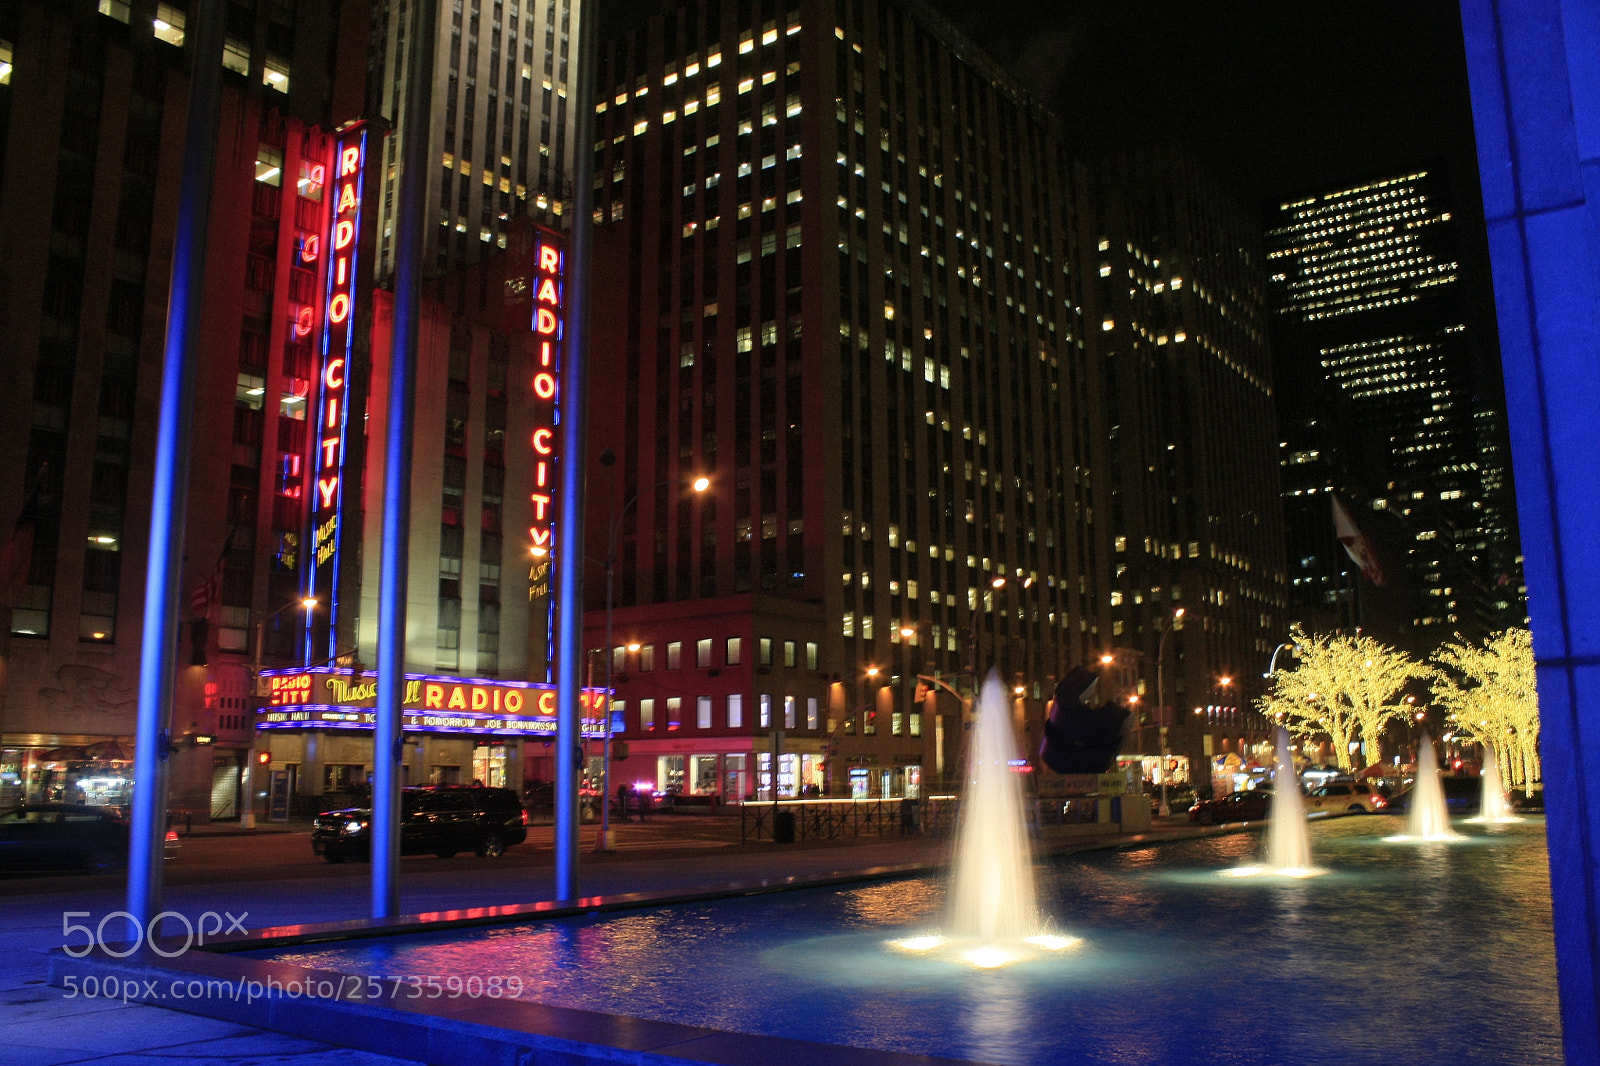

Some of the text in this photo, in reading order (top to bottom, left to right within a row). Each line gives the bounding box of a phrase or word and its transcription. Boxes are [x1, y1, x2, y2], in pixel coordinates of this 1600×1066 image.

[318, 147, 359, 508] RADIO CITY
[533, 245, 559, 399] RADIO
[272, 675, 312, 690] RADIO
[271, 690, 311, 705] CITY
[425, 683, 524, 713] RADIO
[423, 716, 477, 728] TOMORROW
[484, 720, 502, 729] JOE
[506, 721, 558, 731] BONAMASSA
